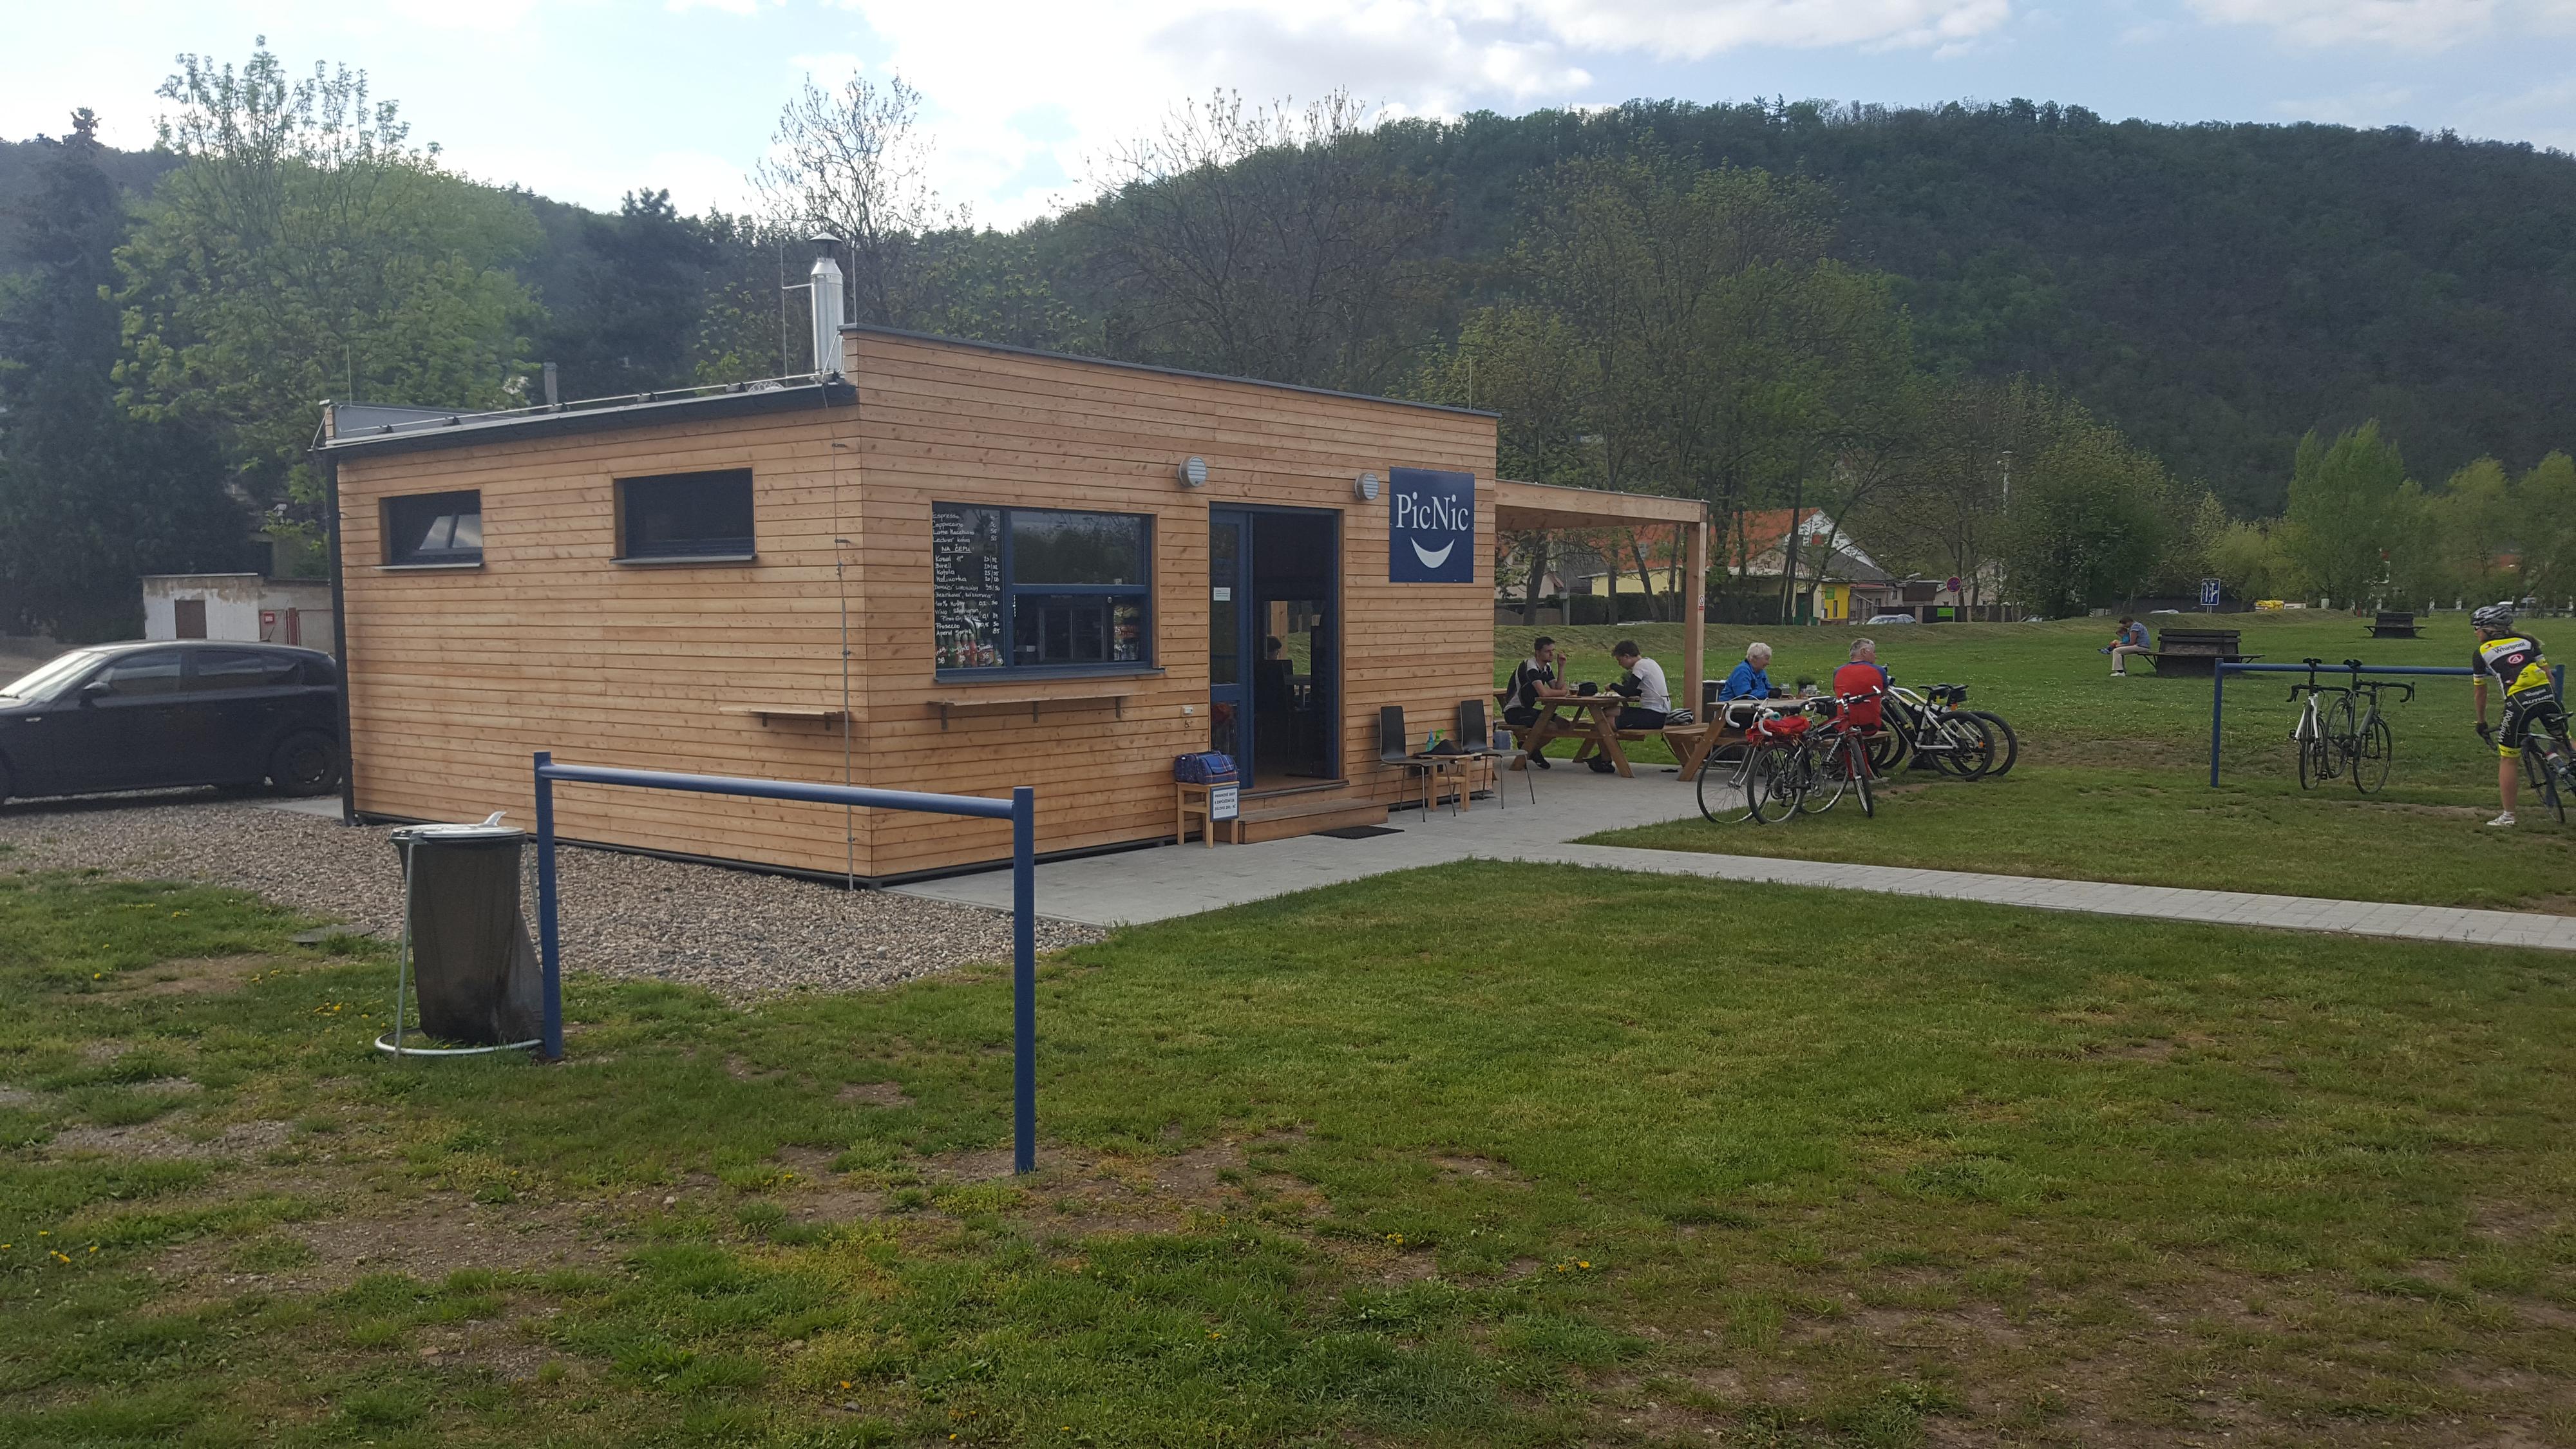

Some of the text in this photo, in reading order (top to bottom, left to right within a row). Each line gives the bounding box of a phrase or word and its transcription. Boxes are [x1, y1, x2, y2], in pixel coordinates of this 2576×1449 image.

[1396, 491, 1468, 531] PicNic
[2494, 642, 2525, 653] Whirlpool
[2498, 710, 2514, 743] Whirlpool
